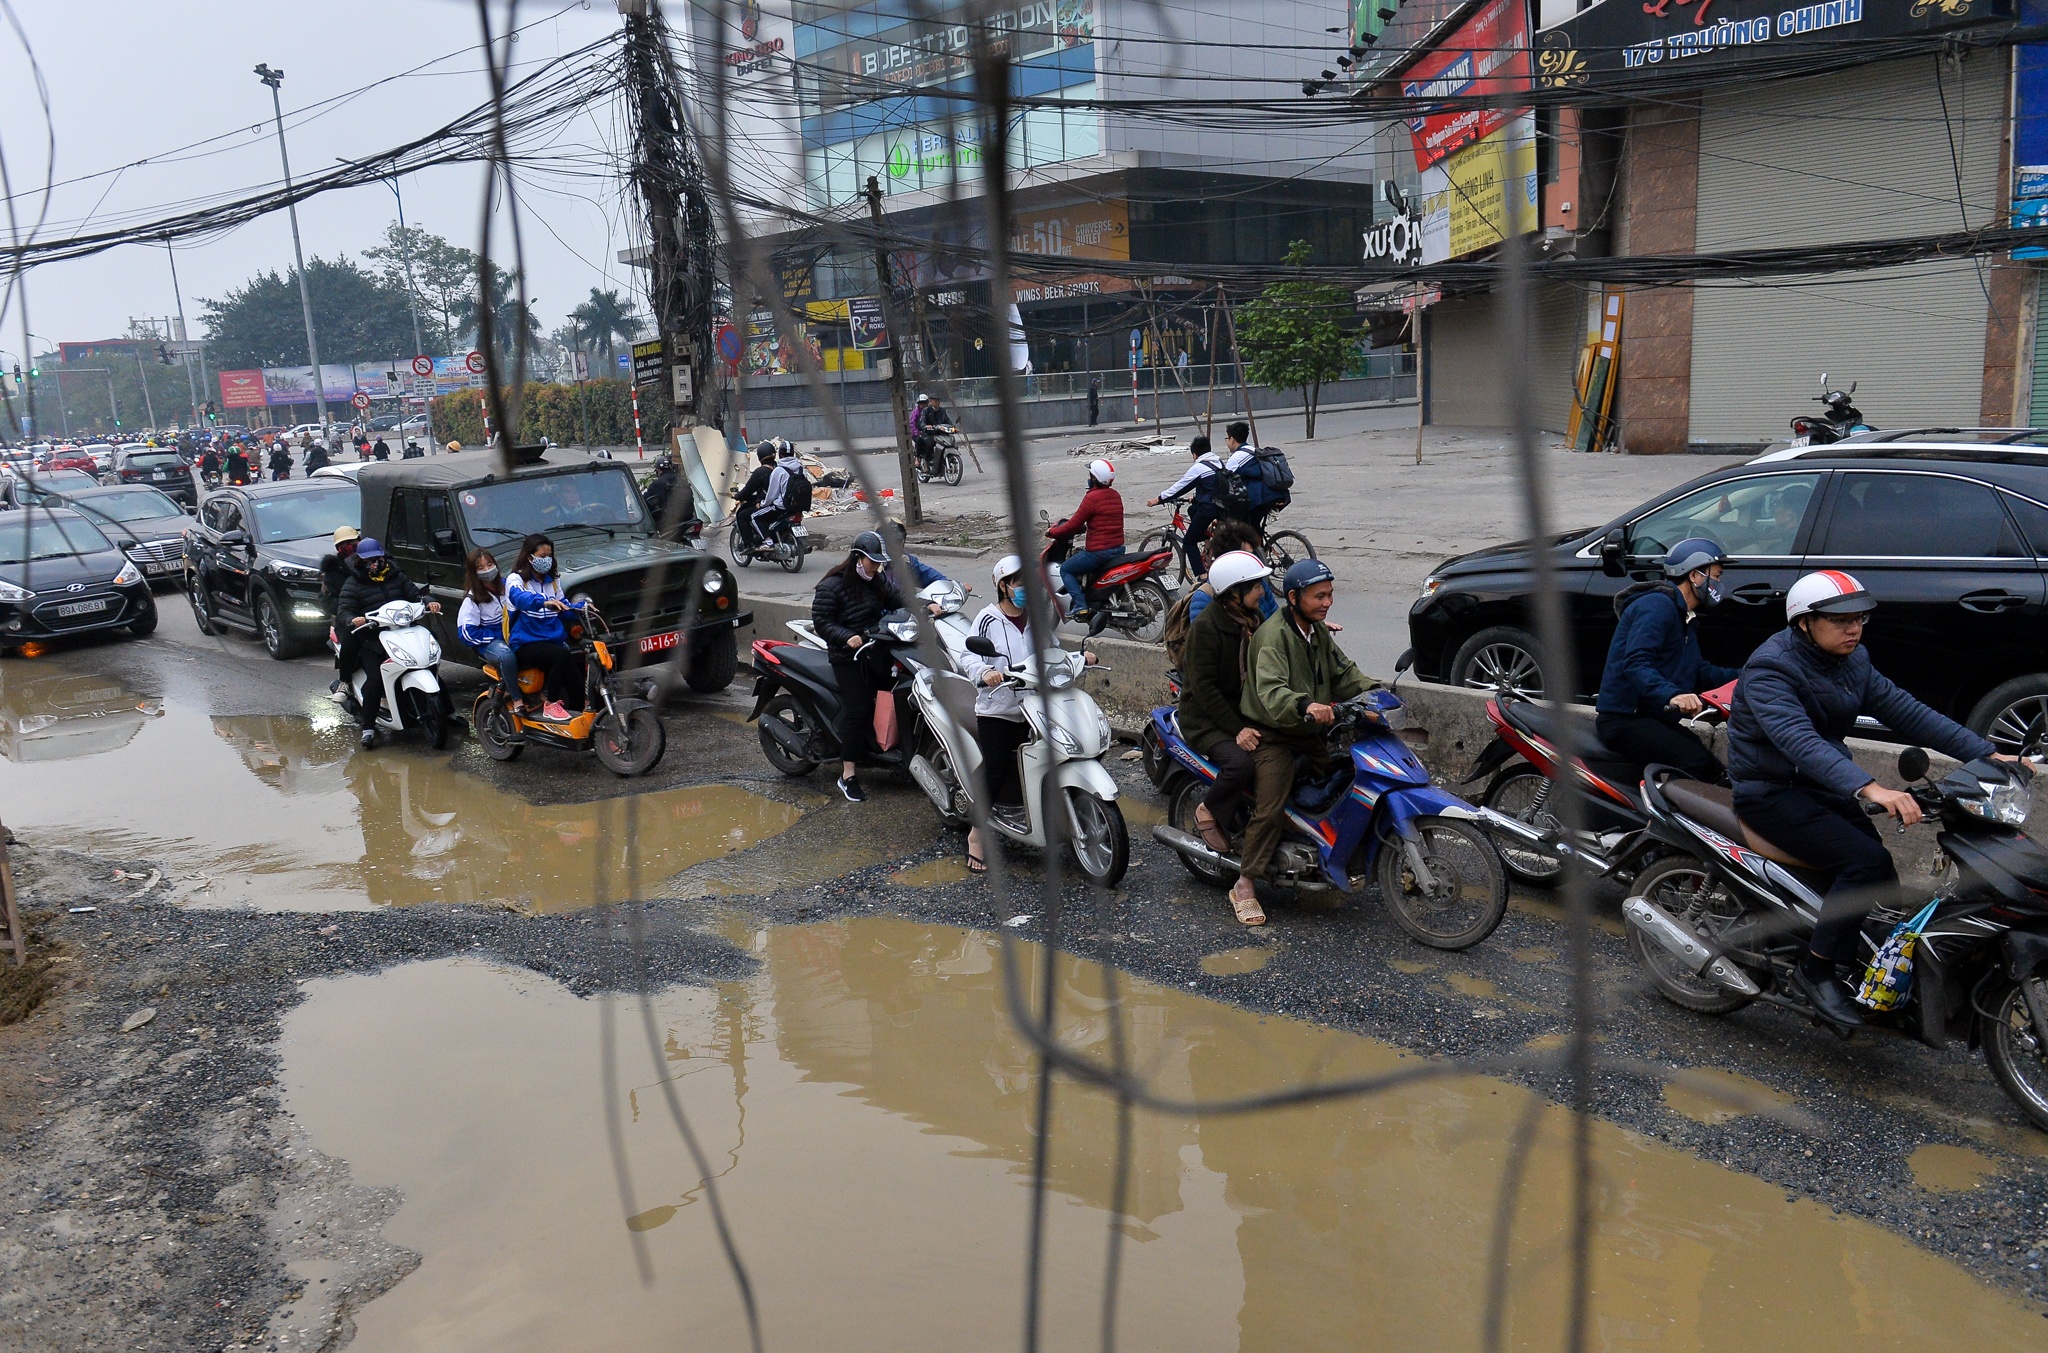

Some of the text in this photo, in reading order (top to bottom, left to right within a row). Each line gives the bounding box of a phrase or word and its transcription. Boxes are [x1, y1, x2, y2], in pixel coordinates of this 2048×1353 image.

[935, 2, 1052, 52] POEIDON
[1622, 0, 1863, 68] 175 TRƯỜNG CHINH
[1448, 56, 1471, 95] PAINT
[1076, 219, 1112, 235] CONVERSE
[1008, 233, 1029, 253] ALE
[1076, 233, 1100, 247] OUTLET
[1016, 288, 1043, 302] WINGS.
[1044, 285, 1066, 299] BEER.
